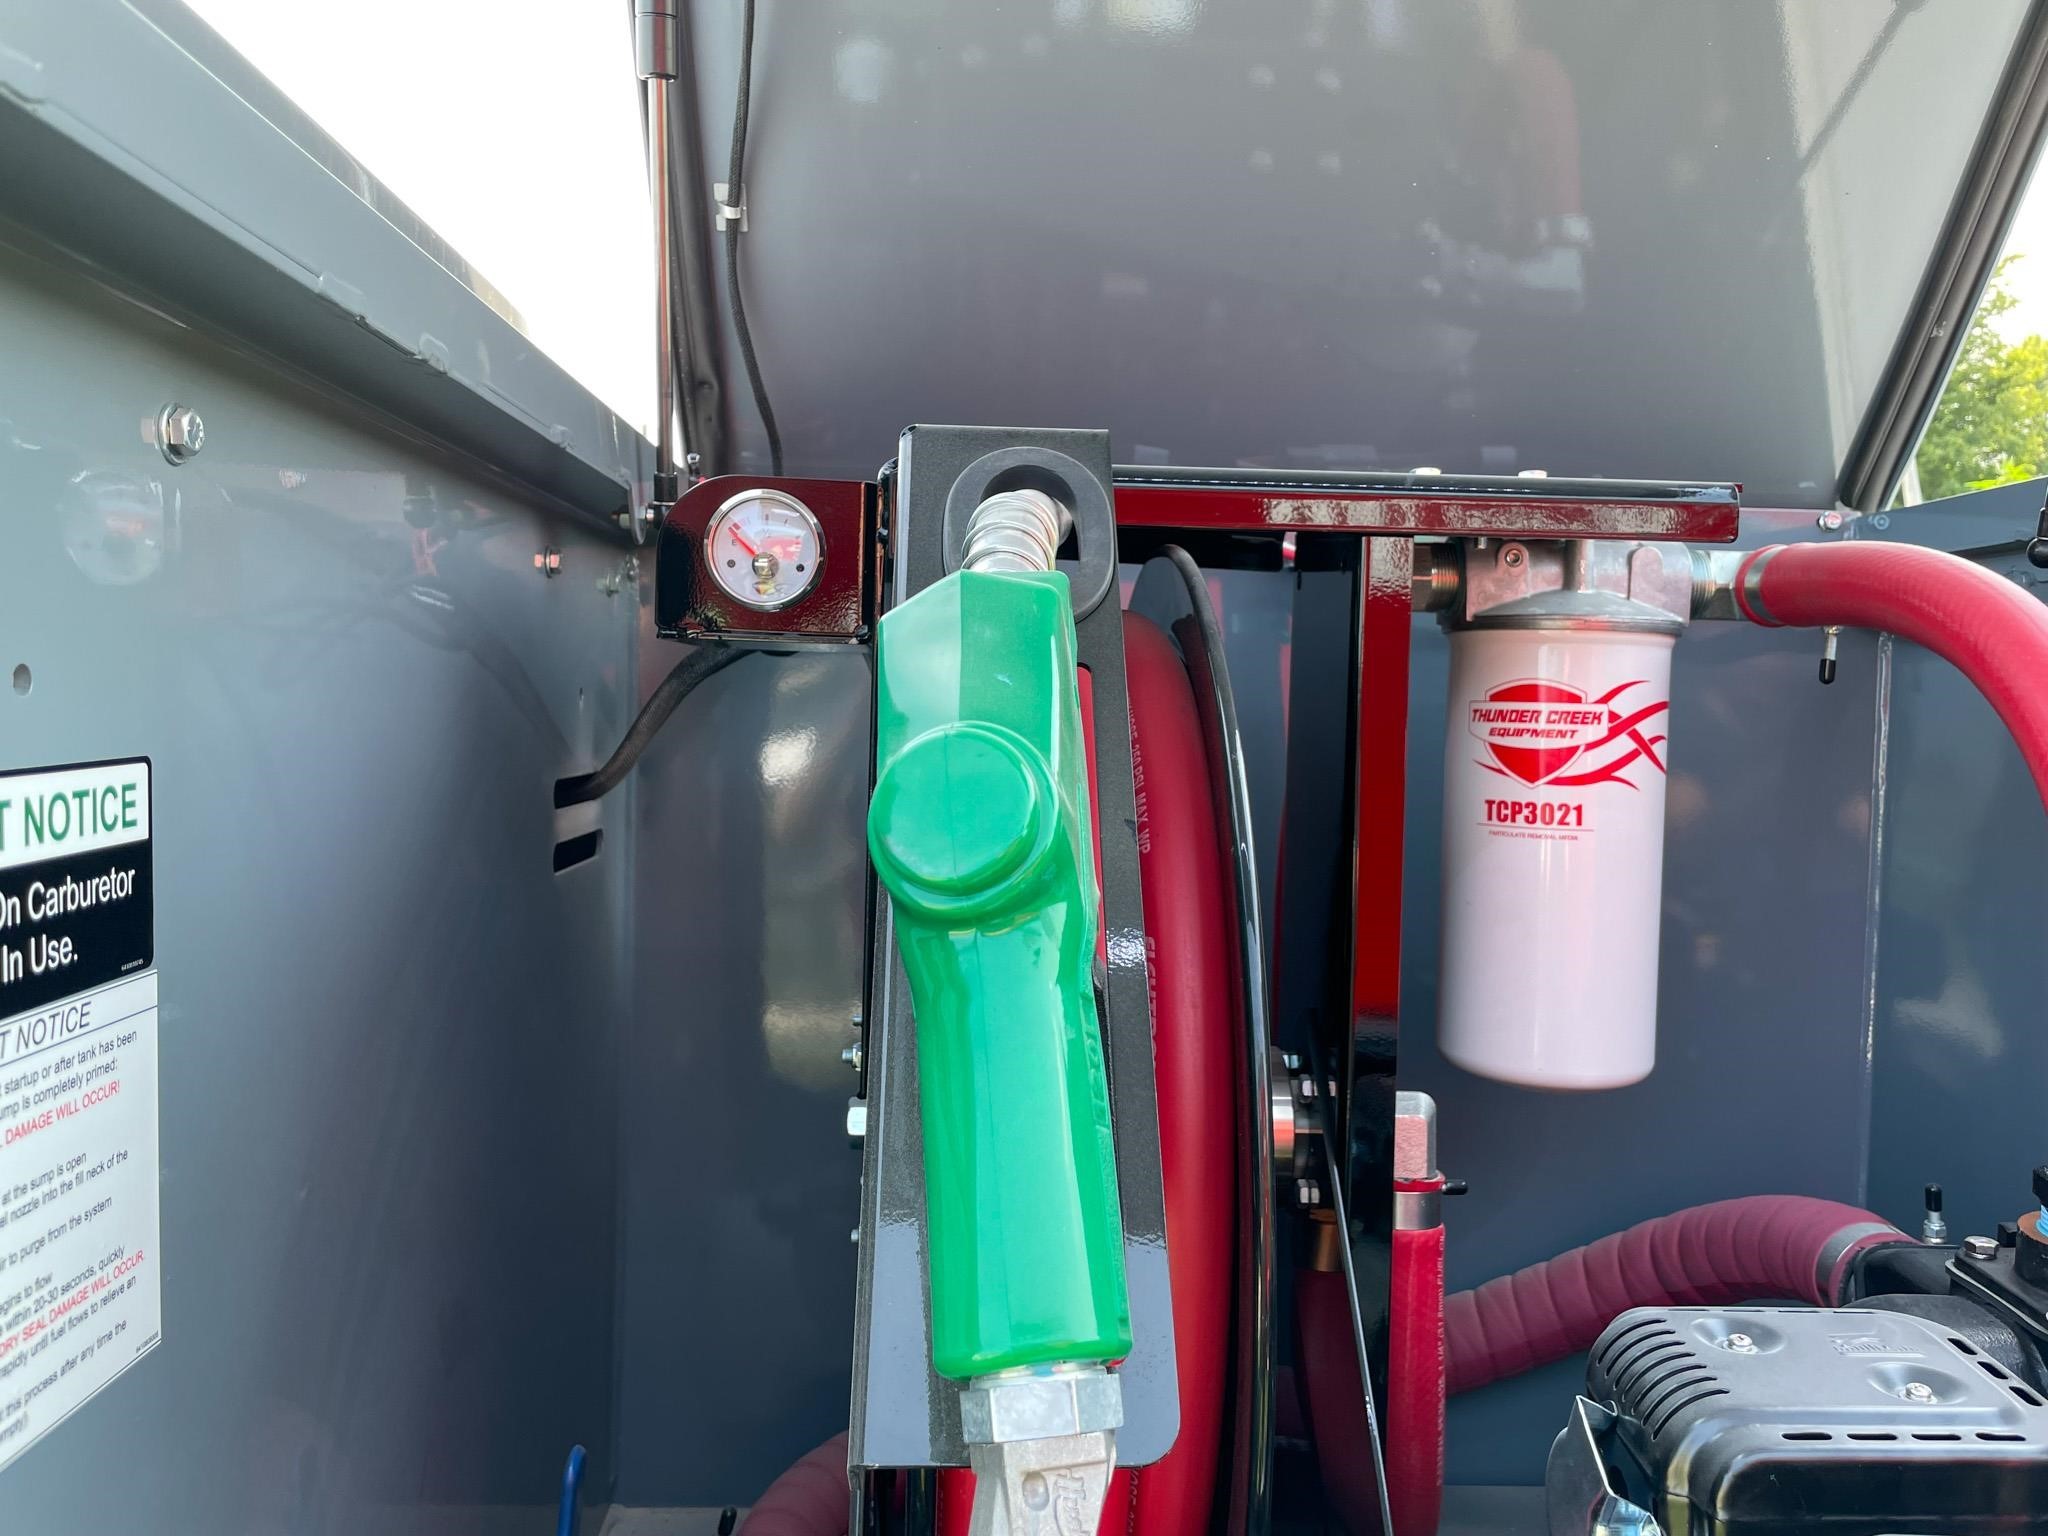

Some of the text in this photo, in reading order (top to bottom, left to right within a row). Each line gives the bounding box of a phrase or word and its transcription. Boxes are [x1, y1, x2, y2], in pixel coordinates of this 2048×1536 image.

[1472, 709, 1604, 725] THUNDER CREEK
[1488, 727, 1578, 739] EQUIPMENT
[24, 783, 138, 847] NOTICE
[1136, 792, 1148, 826] MAX
[1485, 799, 1583, 826] TCP3021
[1138, 828, 1151, 854] WP
[28, 866, 136, 921] Carburetor
[2, 933, 79, 985] In Use.
[16, 1000, 93, 1053] NOTICE
[4, 1071, 39, 1095] startup
[42, 1065, 51, 1079] or
[54, 1055, 75, 1074] after
[77, 1045, 97, 1065] tank
[99, 1040, 115, 1056] has
[116, 1030, 137, 1048] been
[22, 1094, 31, 1111] is
[33, 1072, 83, 1105] completely
[86, 1057, 119, 1087] primed:
[5, 1079, 120, 1145] DAMAGE WILL OCCUR!
[2, 1153, 86, 1205] at the sump is open
[10, 1196, 40, 1222] nozzle
[42, 1188, 57, 1205] into
[60, 1179, 73, 1195] the
[87, 1160, 105, 1180] neck
[107, 1153, 115, 1169] of
[116, 1149, 128, 1164] the
[20, 1236, 45, 1262] purge
[48, 1222, 67, 1242] from
[69, 1214, 81, 1231] the
[84, 1197, 112, 1222] system
[23, 1314, 48, 1341] SEAL
[49, 1286, 89, 1324] DAMAGE
[91, 1271, 111, 1294] WILL
[113, 1249, 144, 1279] OCCUR
[33, 1286, 59, 1314] 20-30
[60, 1265, 96, 1296] seconds,
[98, 1245, 125, 1272] quickly
[24, 1371, 57, 1406] process
[115, 1320, 127, 1336] the
